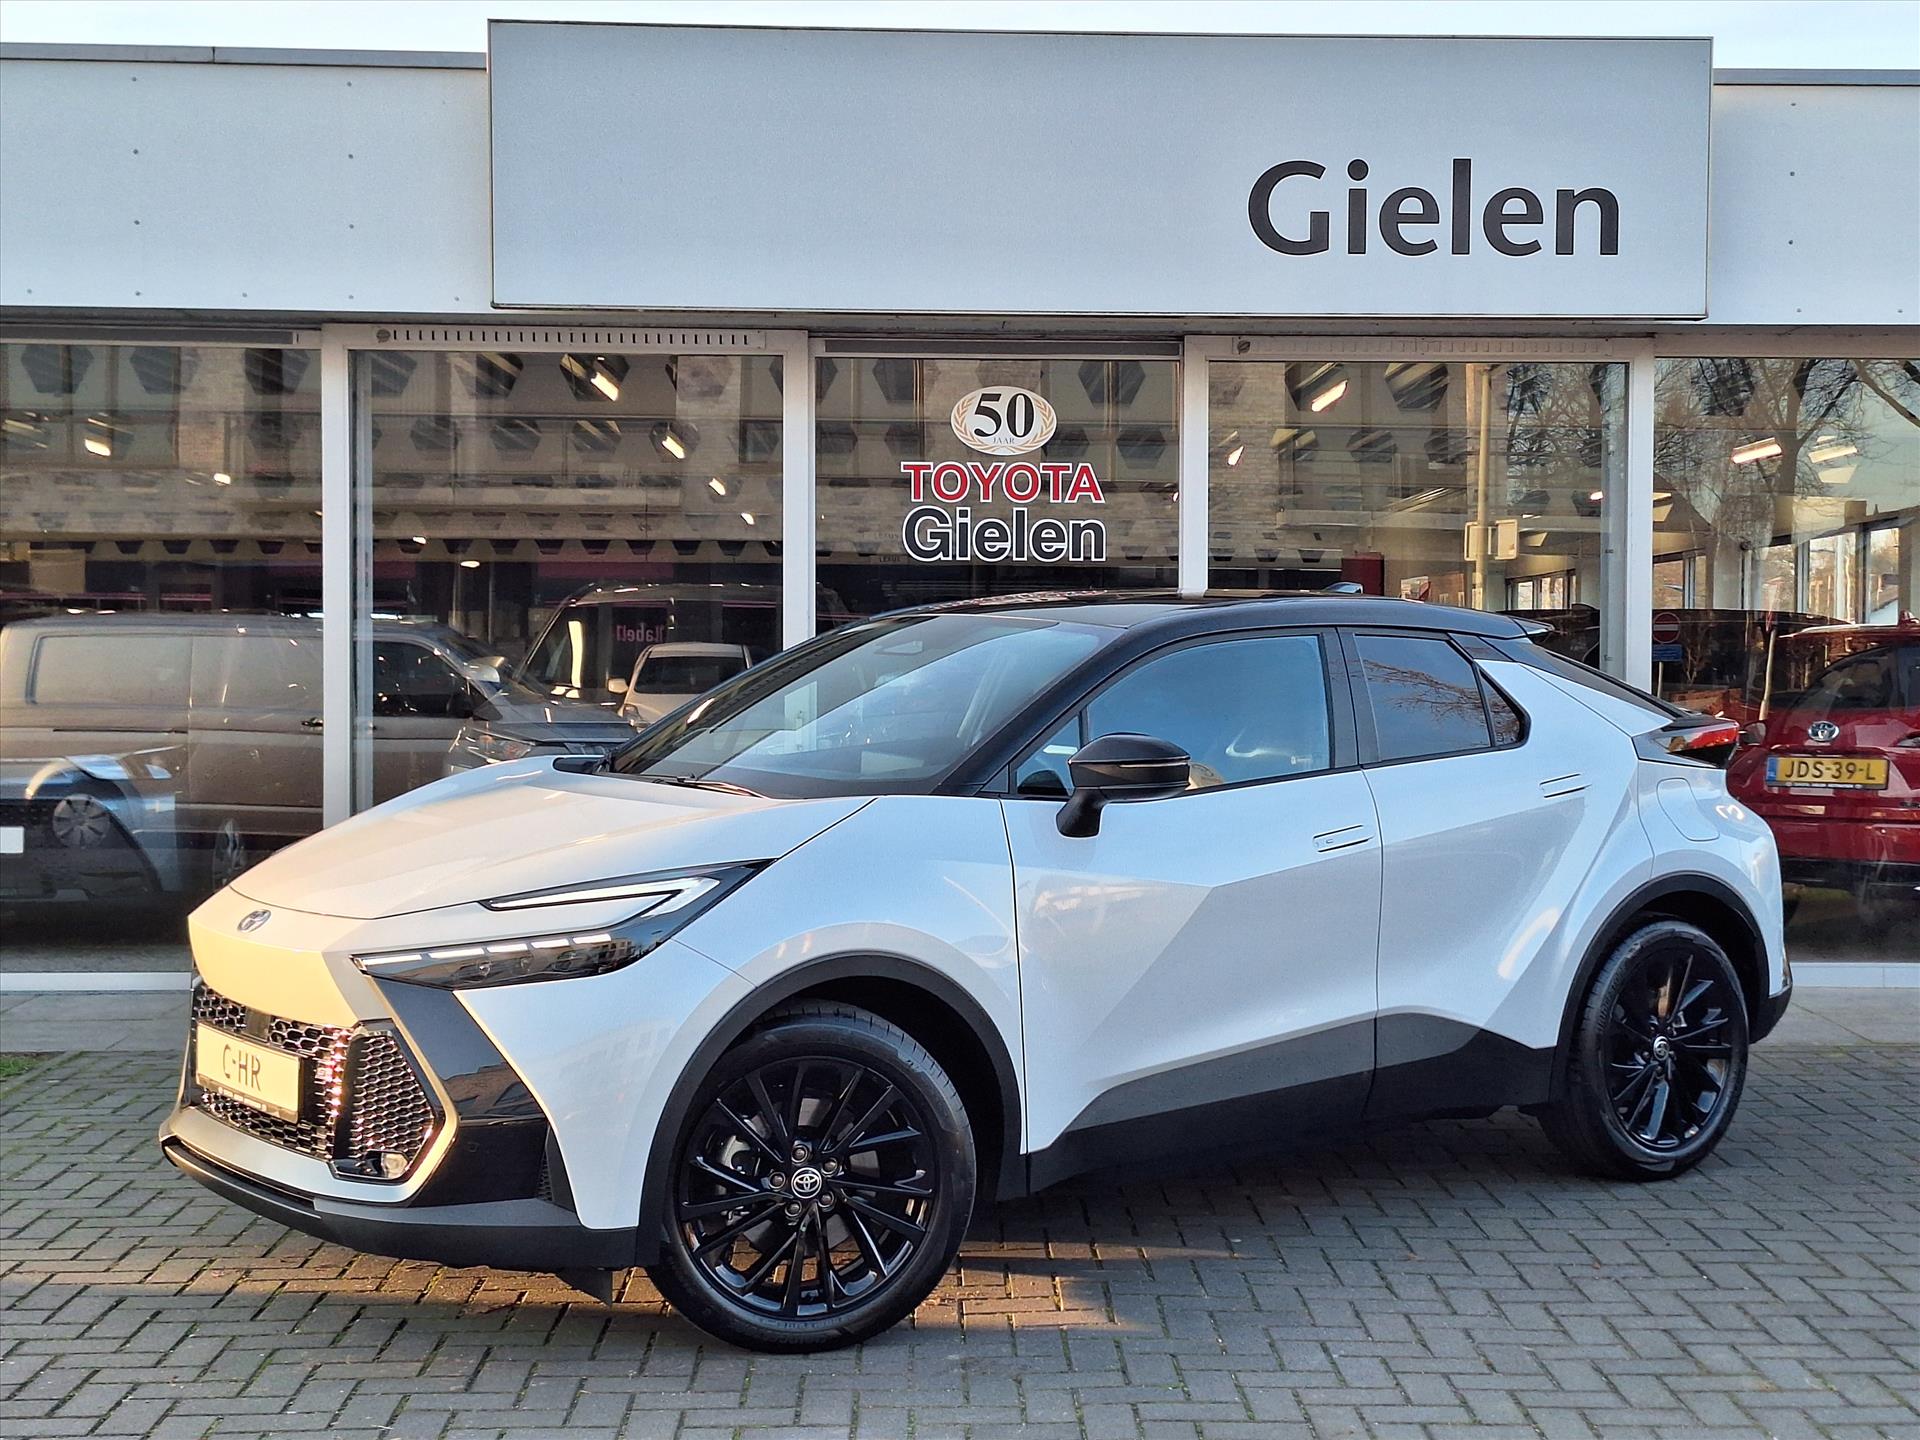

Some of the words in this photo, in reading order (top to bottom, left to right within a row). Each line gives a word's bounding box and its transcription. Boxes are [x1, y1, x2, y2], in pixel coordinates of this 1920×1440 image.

[1247, 157, 1620, 257] Gielen
[973, 393, 1035, 438] 50
[993, 437, 1015, 445] JAAR
[901, 461, 1106, 504] TOYOTA
[902, 505, 1107, 562] Gielen
[1784, 761, 1876, 781] JDS-39-L
[222, 1043, 262, 1092] C-HR
